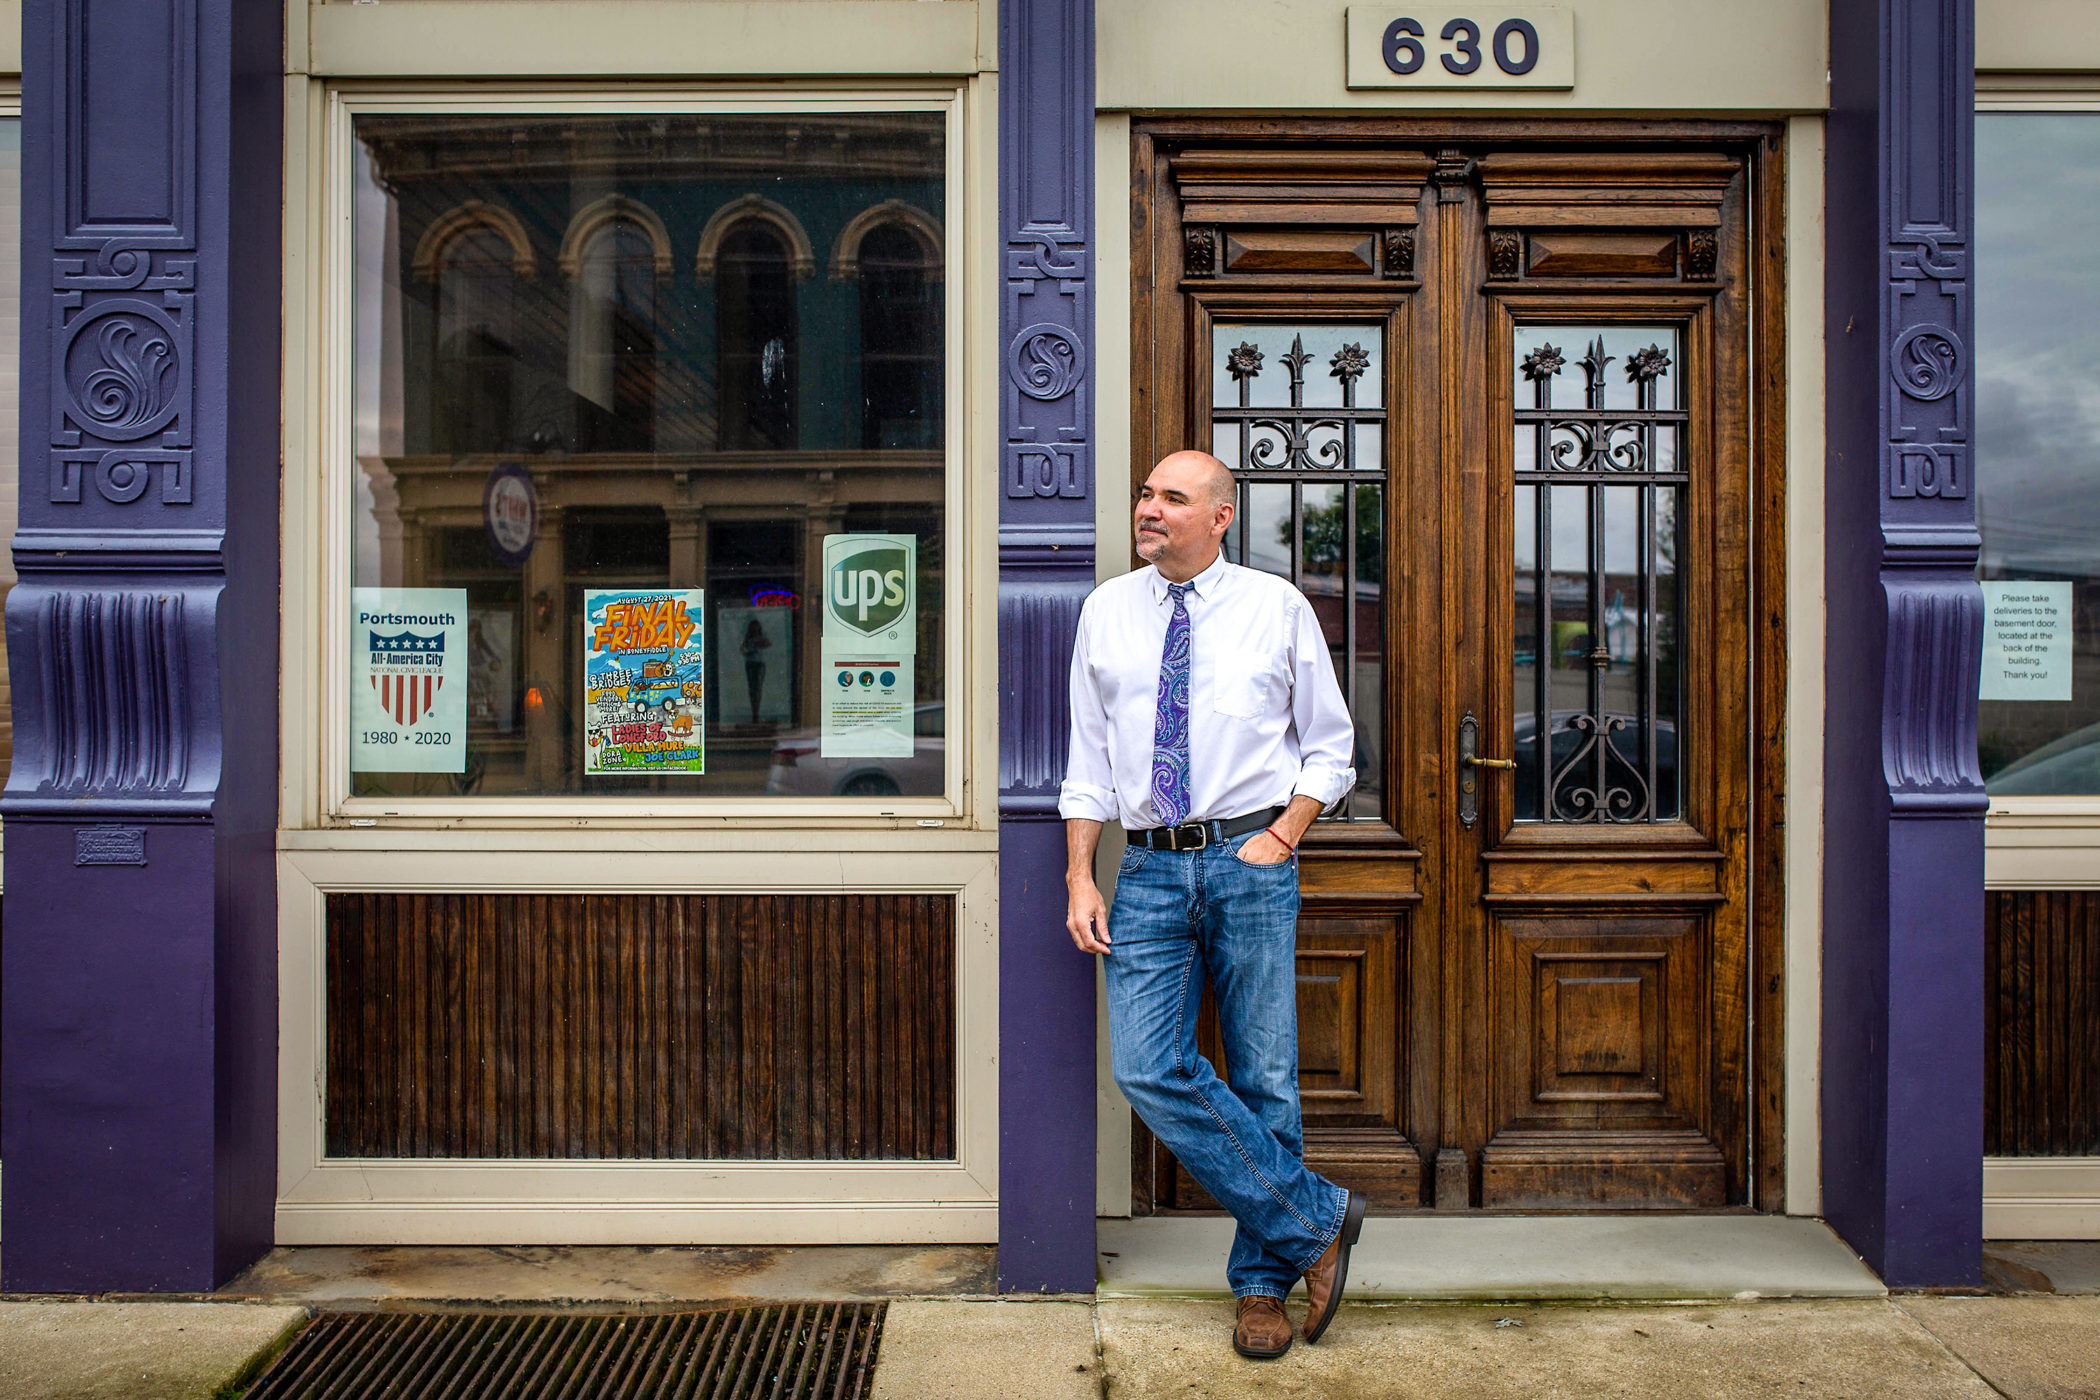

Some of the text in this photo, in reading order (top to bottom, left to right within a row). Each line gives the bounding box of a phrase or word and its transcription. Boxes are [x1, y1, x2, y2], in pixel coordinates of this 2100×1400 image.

[1382, 17, 1539, 75] 630
[617, 597, 642, 605] AUGUST
[2002, 594, 2049, 602] Please take
[360, 612, 455, 626] Portsmouth
[2036, 620, 2057, 628] door,
[371, 653, 443, 667] All-America City
[2008, 657, 2041, 666] building.
[600, 669, 632, 681] THREE
[2003, 671, 2047, 680] Thank you!
[612, 722, 662, 734] LADIES OF
[362, 731, 451, 745] 1980 2020
[612, 731, 667, 744] LONGFORD
[624, 741, 684, 753] VILLA MURE
[602, 750, 621, 758] DORA
[645, 749, 700, 762] JOE CLARK
